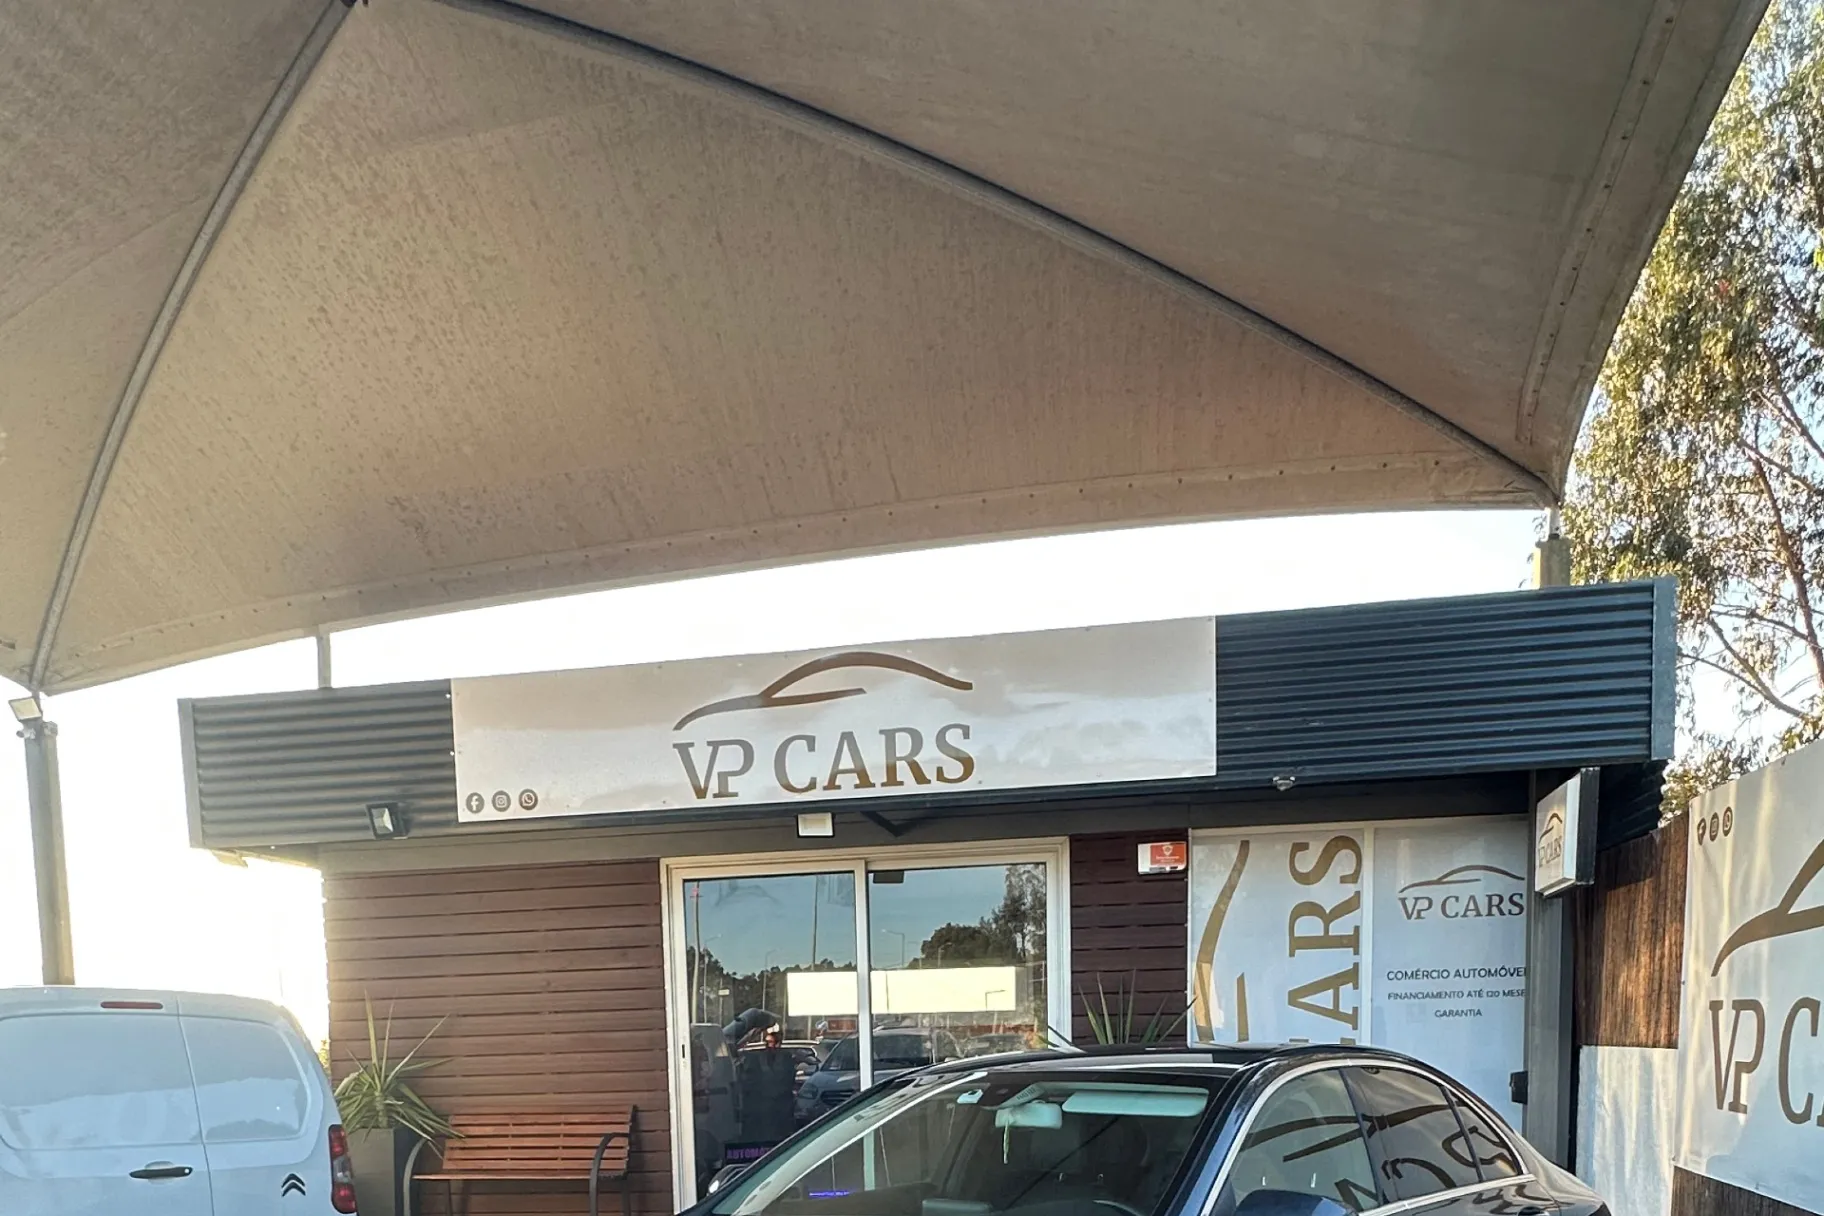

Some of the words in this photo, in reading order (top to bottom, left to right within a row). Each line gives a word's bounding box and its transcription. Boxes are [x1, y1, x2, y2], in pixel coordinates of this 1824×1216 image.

[672, 738, 755, 800] VP
[773, 722, 976, 794] CARS
[1397, 896, 1434, 921] VP
[1441, 892, 1525, 919] CARS
[1288, 834, 1363, 1046] ARS
[1386, 967, 1451, 981] COMÉRCIO
[1387, 990, 1465, 1001] FINANCIAMENTO
[1466, 988, 1484, 998] ATÉ
[1502, 988, 1526, 998] MESE
[1434, 1008, 1483, 1018] GARANTIA
[1708, 998, 1766, 1115] VP
[1778, 996, 1824, 1128] C
